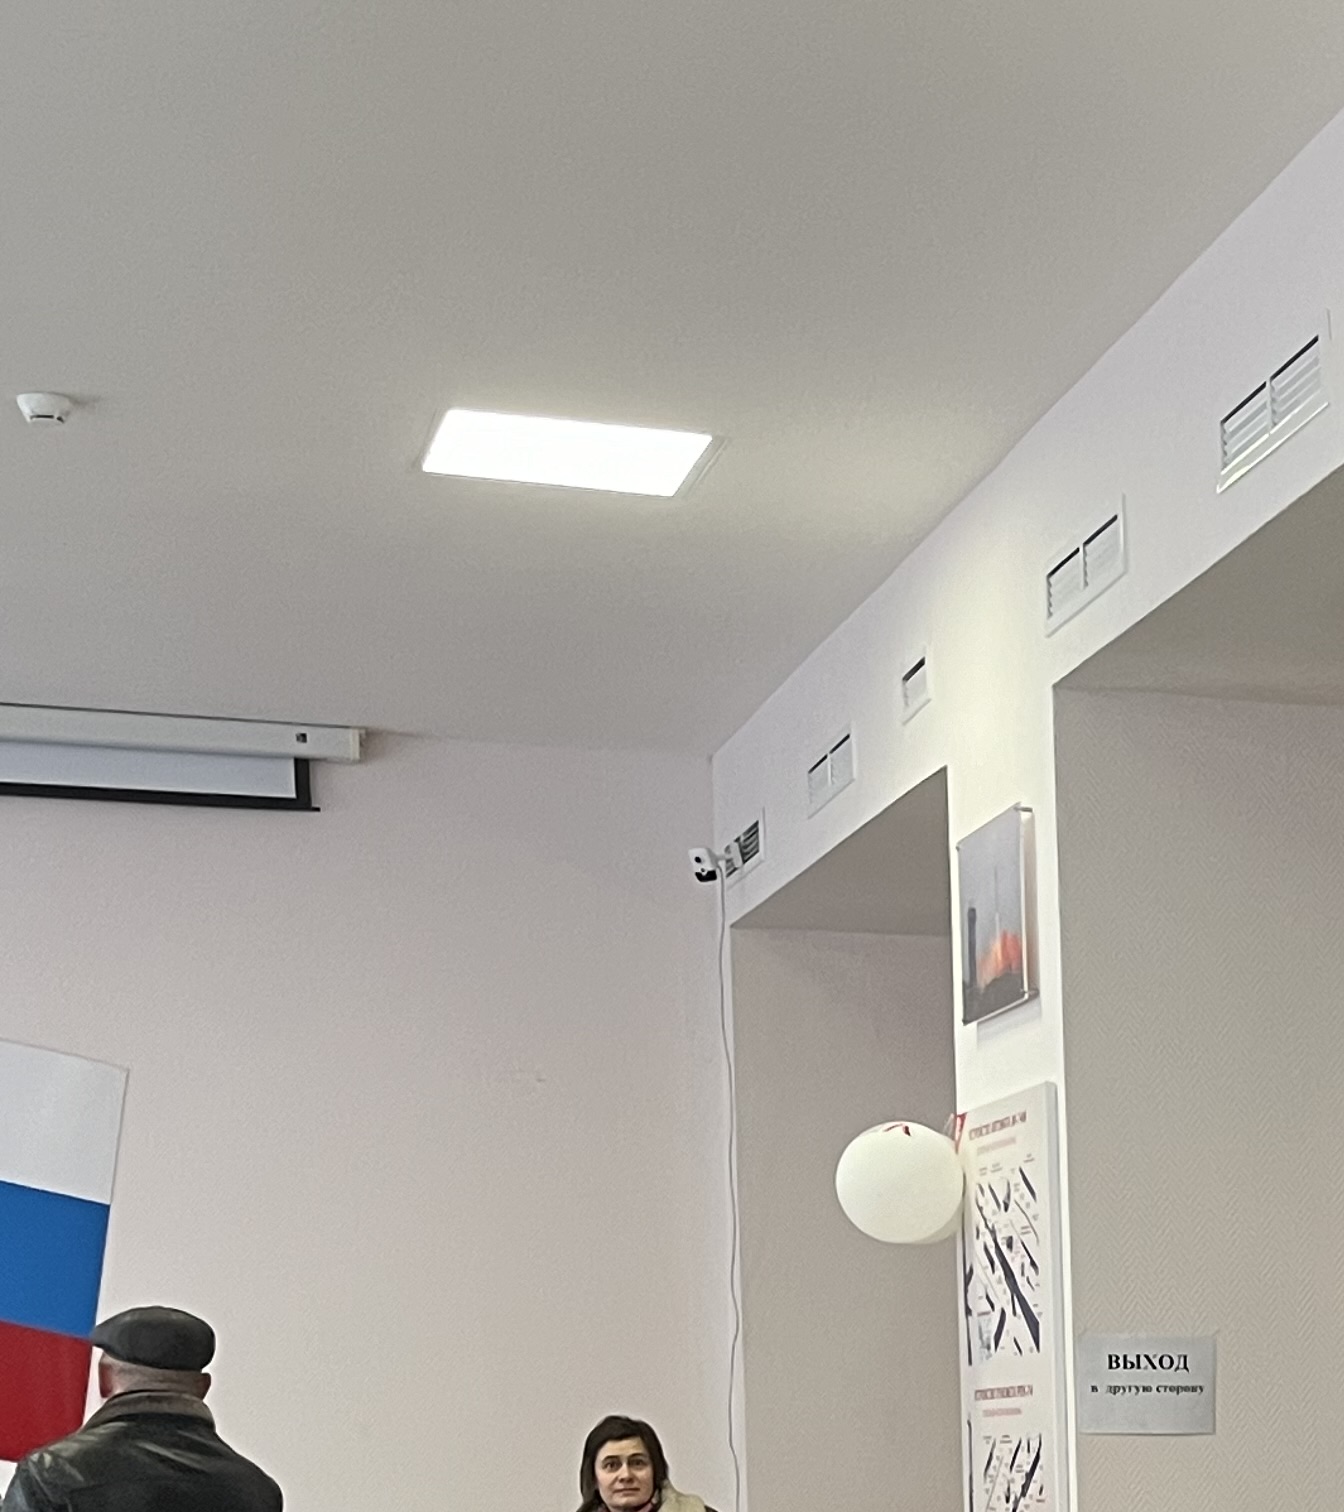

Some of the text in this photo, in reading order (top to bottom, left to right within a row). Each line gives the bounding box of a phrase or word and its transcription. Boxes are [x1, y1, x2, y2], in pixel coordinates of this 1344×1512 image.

[1107, 1353, 1190, 1373] ВЫХОД
[1090, 1384, 1204, 1396] в другую сторону
